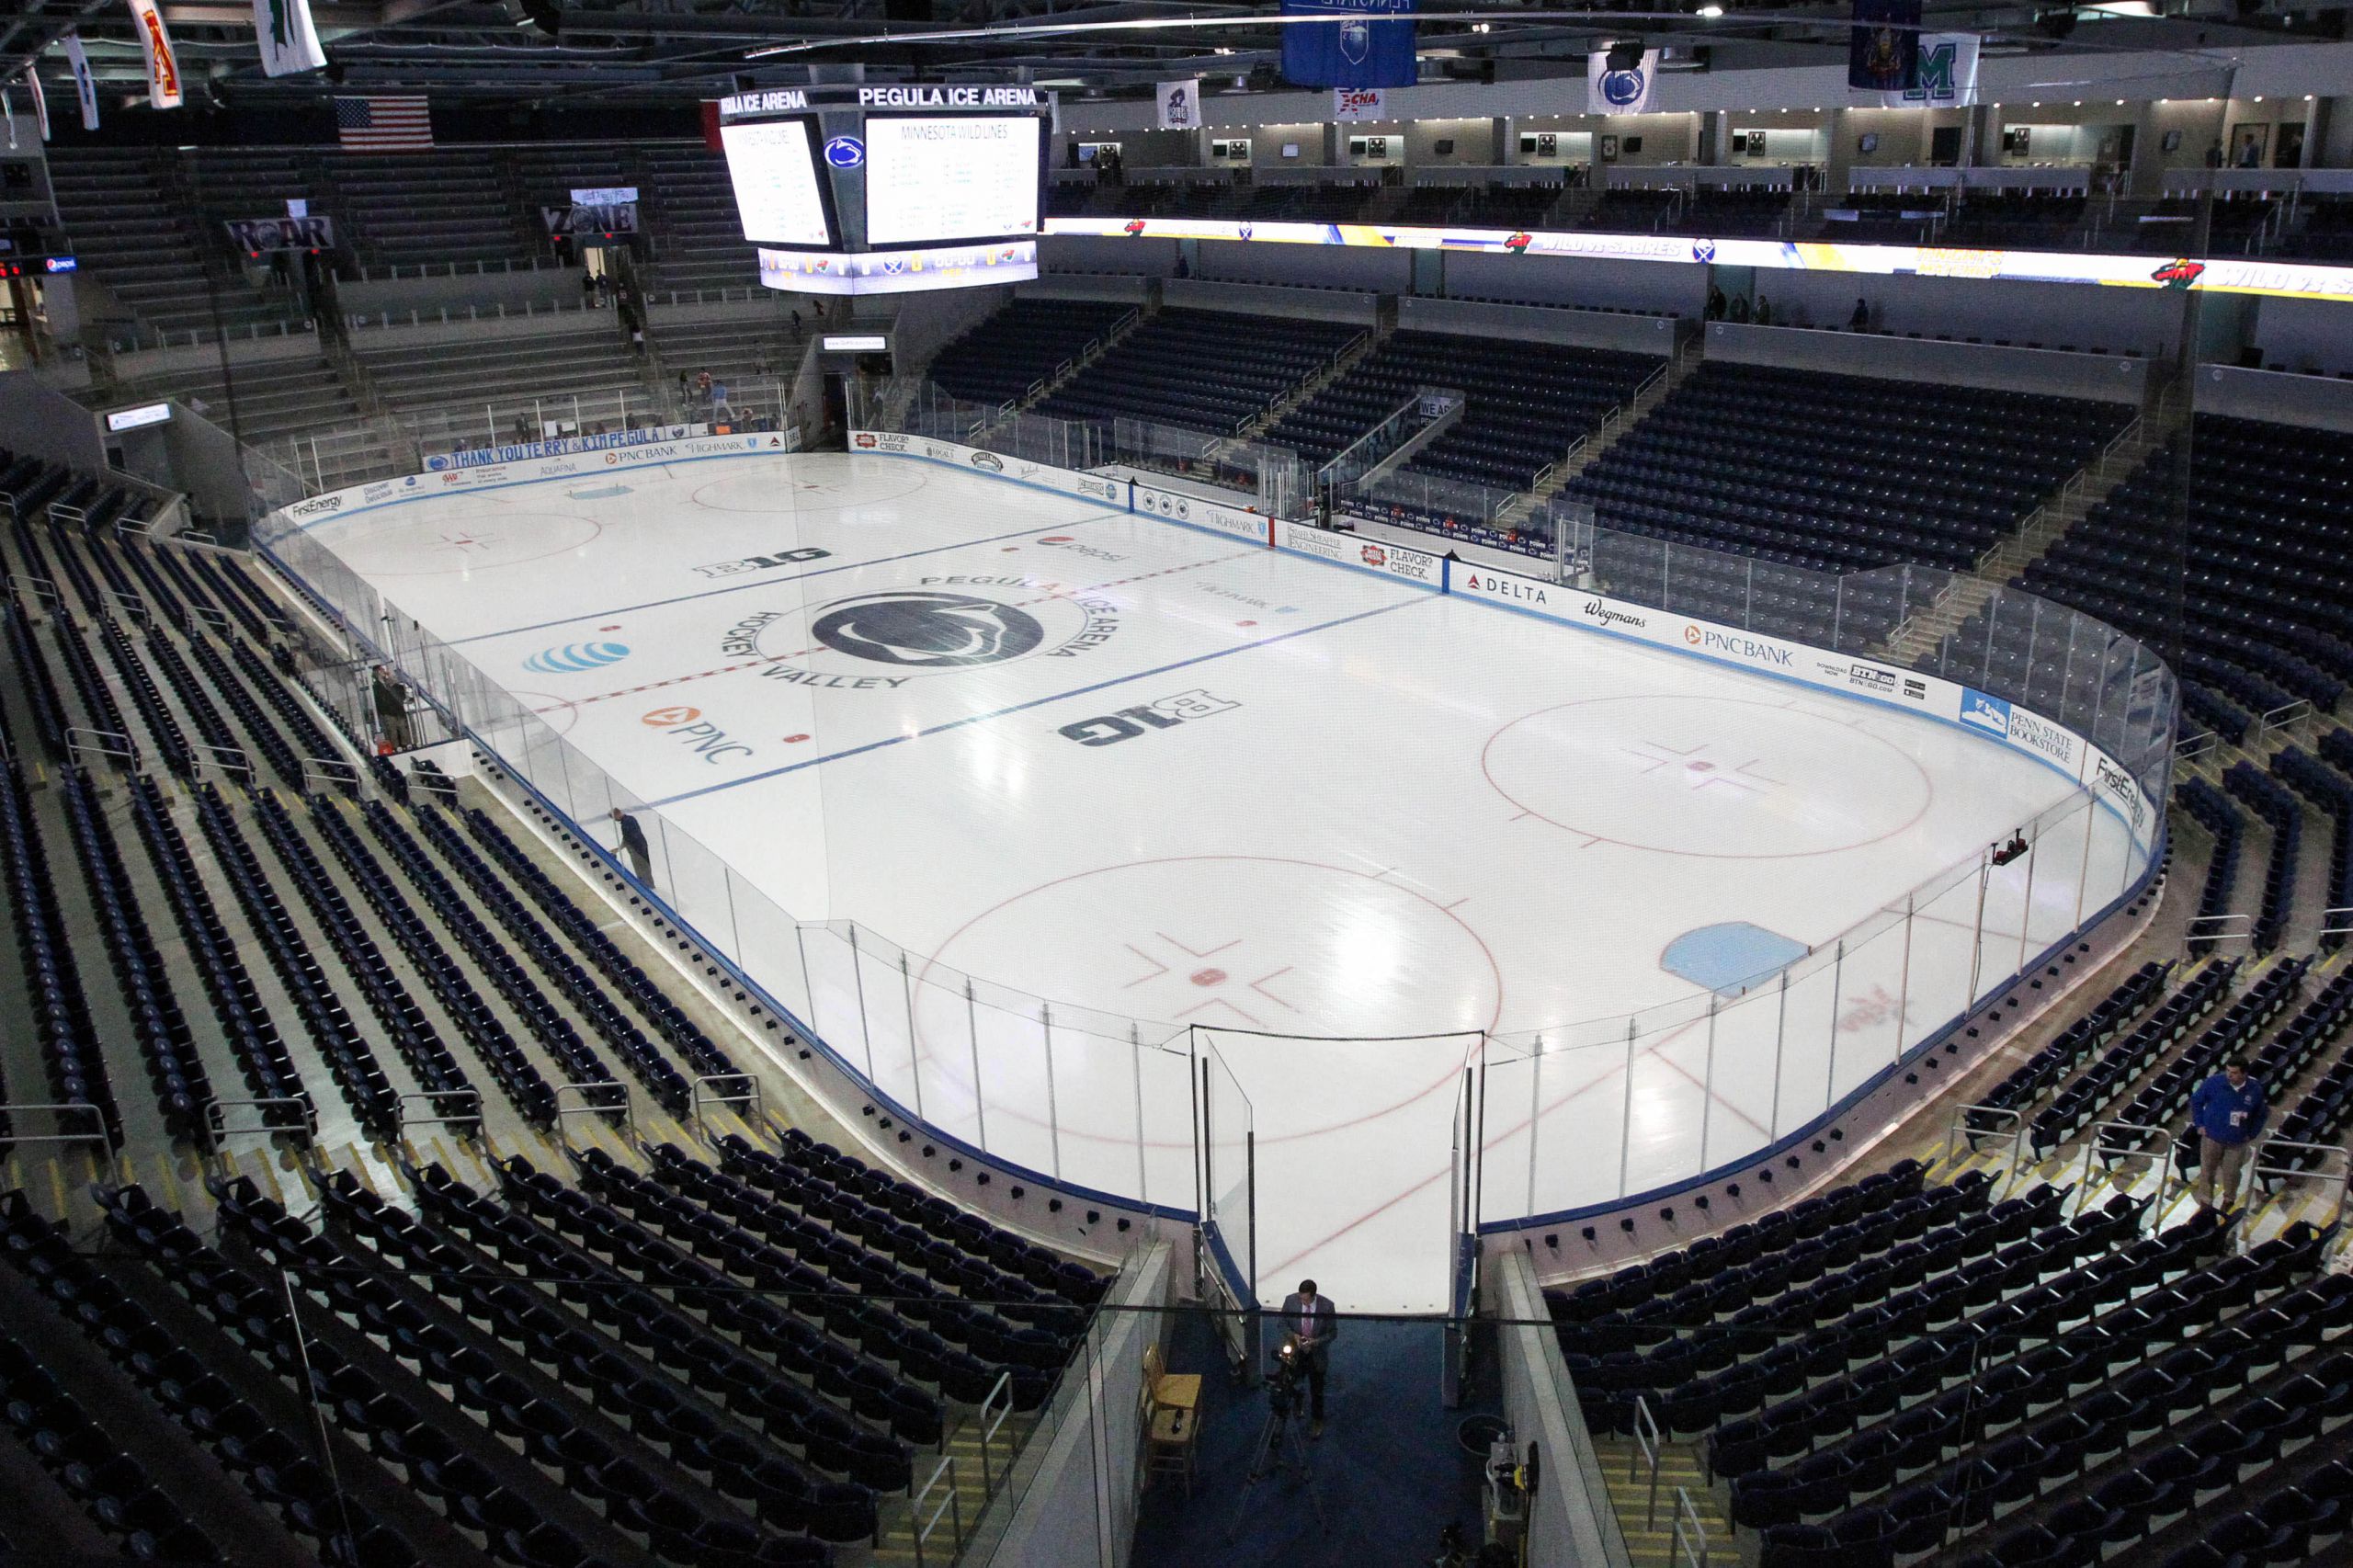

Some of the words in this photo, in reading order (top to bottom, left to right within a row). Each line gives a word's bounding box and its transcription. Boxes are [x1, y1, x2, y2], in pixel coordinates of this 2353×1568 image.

[744, 94, 760, 112] ICE
[762, 90, 807, 110] ARENA
[858, 87, 945, 106] PEGULA
[948, 88, 979, 106] ICE
[983, 88, 1038, 106] ARENA
[901, 125, 957, 141] MINNESOTA
[959, 125, 983, 140] WILD
[983, 124, 1008, 140] LINES
[1541, 235, 1584, 251] WILD
[1608, 241, 1683, 257] SABRES
[451, 449, 494, 468] THANK
[497, 443, 524, 462] YOU
[526, 438, 568, 460] TERRY
[571, 438, 582, 451] &
[581, 434, 608, 450] KIM
[609, 427, 660, 448] PEGULA
[619, 451, 643, 461] PNC
[644, 445, 678, 460] BANK
[690, 441, 743, 453] HIGHMARK
[540, 462, 577, 476] AQUAFINA
[292, 494, 343, 517] FirstEnergy
[1210, 511, 1256, 534] HIGHMARK
[1290, 537, 1343, 560] ENGINEERING
[1390, 549, 1434, 568] FLAVOR?
[1390, 562, 1428, 580] CHECK.
[921, 575, 1060, 591] PEGULA
[1486, 578, 1547, 605] DELTA
[1078, 597, 1118, 619] ICE
[1583, 598, 1647, 629] Wegmans
[722, 611, 782, 658] HOCKEY
[1046, 614, 1120, 659] ARENA
[1704, 631, 1741, 654] PNC
[1744, 642, 1794, 668] BANK
[760, 666, 914, 690] VALLEY
[2010, 711, 2041, 733] PENN
[2043, 727, 2073, 751] STATE
[668, 721, 754, 765] PNC
[2009, 726, 2071, 764] BOOKSTORE
